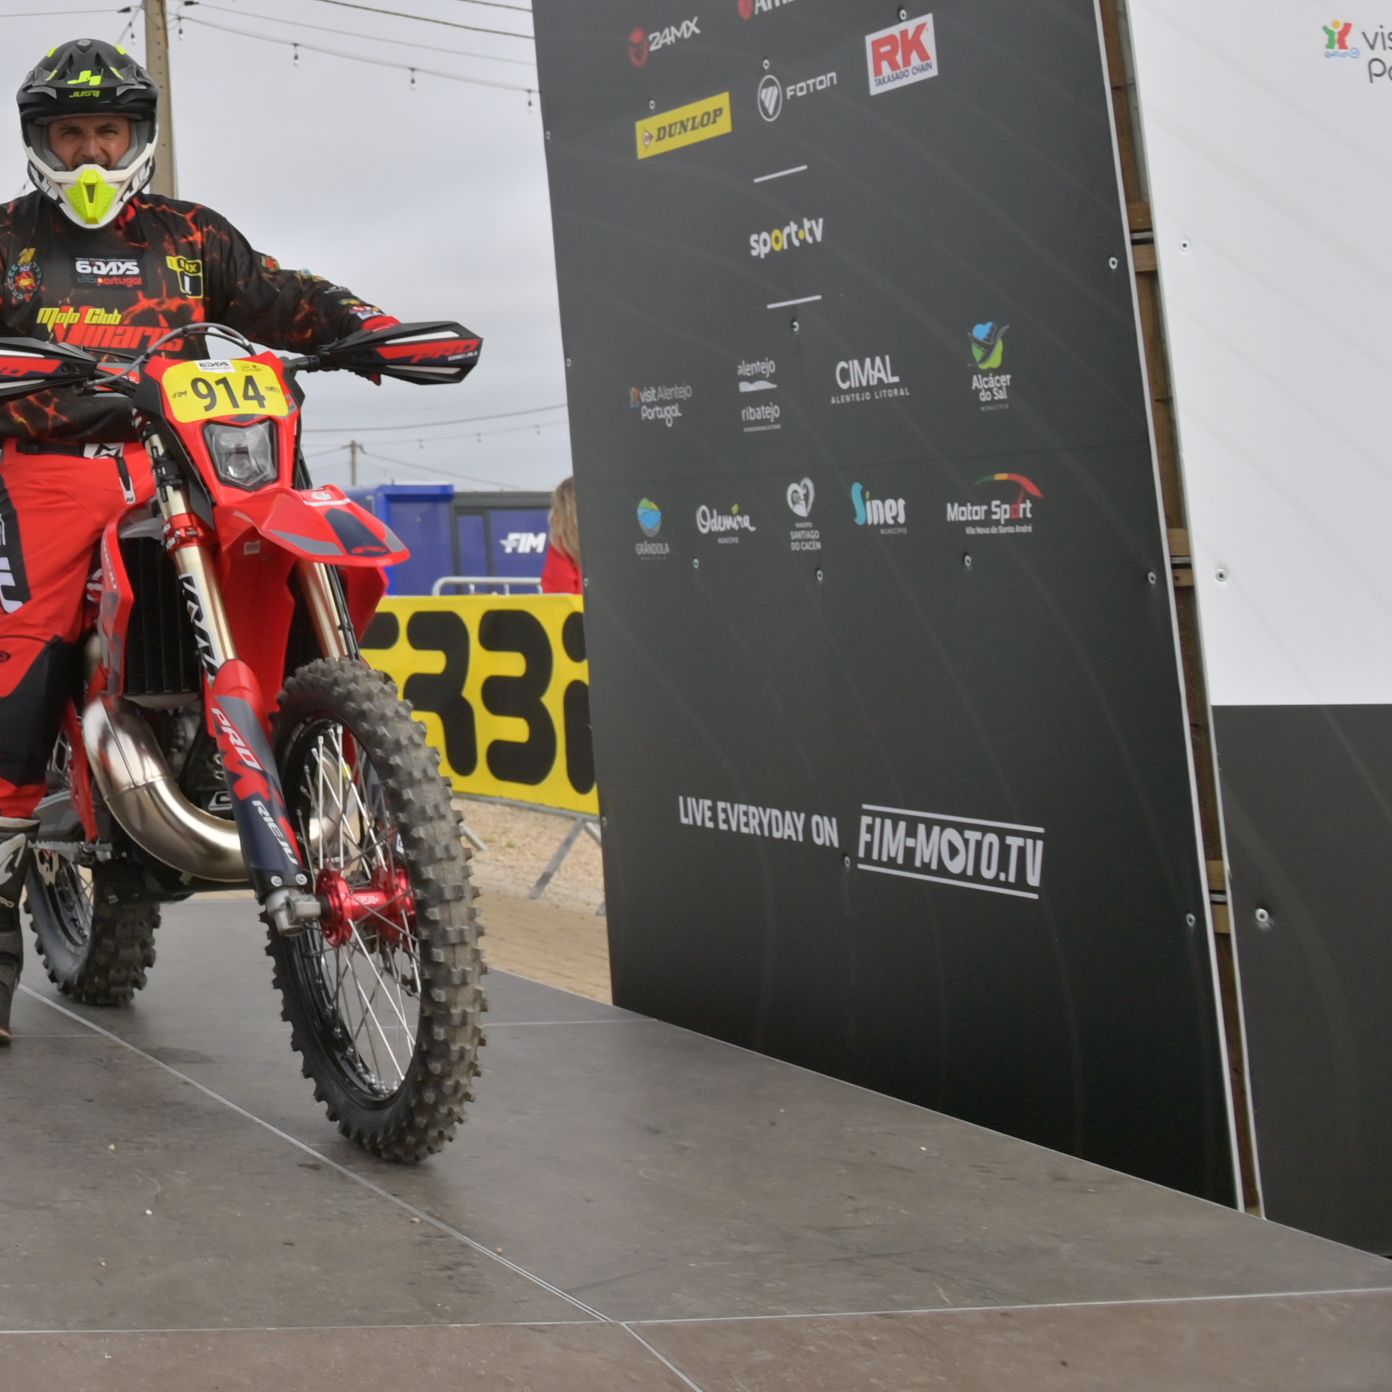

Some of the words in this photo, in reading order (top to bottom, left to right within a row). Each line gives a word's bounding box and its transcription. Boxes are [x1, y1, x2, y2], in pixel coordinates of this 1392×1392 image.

[649, 16, 701, 51] 24MX
[871, 21, 932, 78] RK
[786, 72, 837, 100] FOTON
[874, 71, 910, 88] TAKASAGO
[911, 62, 933, 79] CHAIN
[656, 107, 723, 142] DUNLOP
[737, 358, 776, 377] alentejo
[835, 355, 900, 389] CIMAL
[972, 373, 1012, 390] Alcácer
[190, 375, 267, 412] 914
[831, 392, 871, 404] ALENTEJO
[874, 387, 910, 400] LITORAL
[979, 389, 992, 402] do
[994, 387, 1007, 401] Sal
[641, 403, 682, 427] Portugal
[741, 402, 780, 422] ribatejo
[851, 482, 906, 526] Sines
[946, 502, 988, 522] Motor
[991, 499, 1032, 525] Sport
[696, 504, 757, 534] Odemira
[500, 531, 546, 553] FIM
[211, 707, 264, 772] PRO
[251, 799, 298, 866] RIEJU
[678, 795, 715, 829] LIVE
[717, 801, 805, 842] EVERYDAY
[811, 814, 839, 848] ON
[858, 815, 1044, 887] FIM-MOTO.TV
